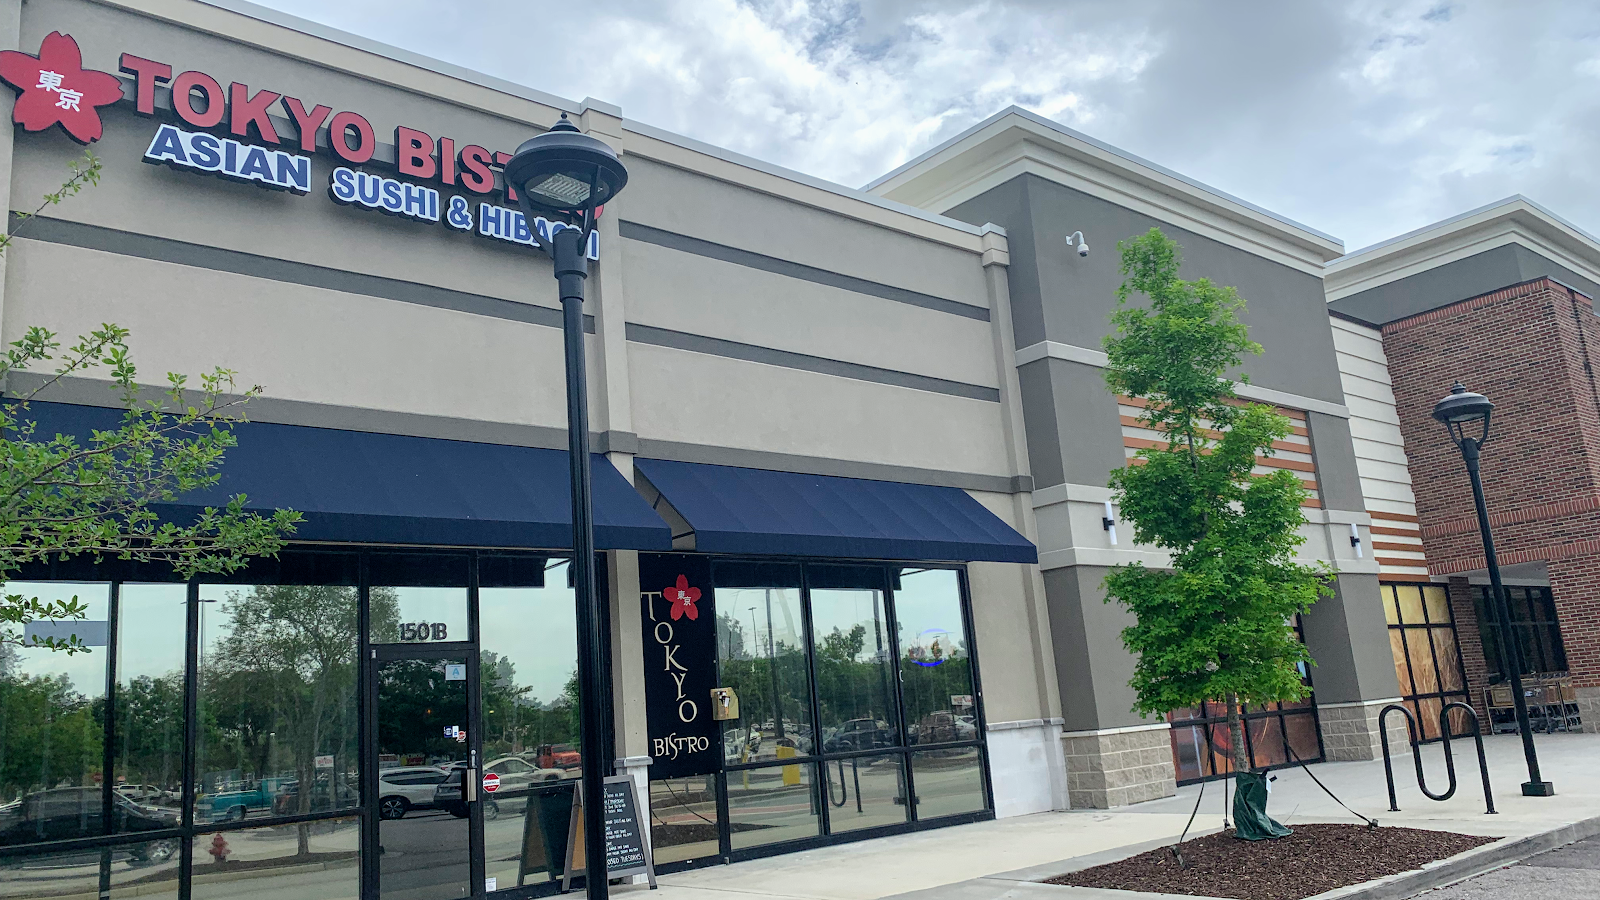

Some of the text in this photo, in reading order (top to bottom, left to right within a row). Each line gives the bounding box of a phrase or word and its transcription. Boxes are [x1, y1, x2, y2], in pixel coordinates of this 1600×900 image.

[36, 69, 84, 112] 東京
[120, 53, 604, 219] TOKYO BIS
[147, 125, 598, 259] ASIAN SUSHI & HIBAI
[399, 622, 448, 641] 1501B
[452, 667, 460, 676] A
[640, 591, 698, 722] TOKYO
[653, 732, 709, 760] BISTRO
